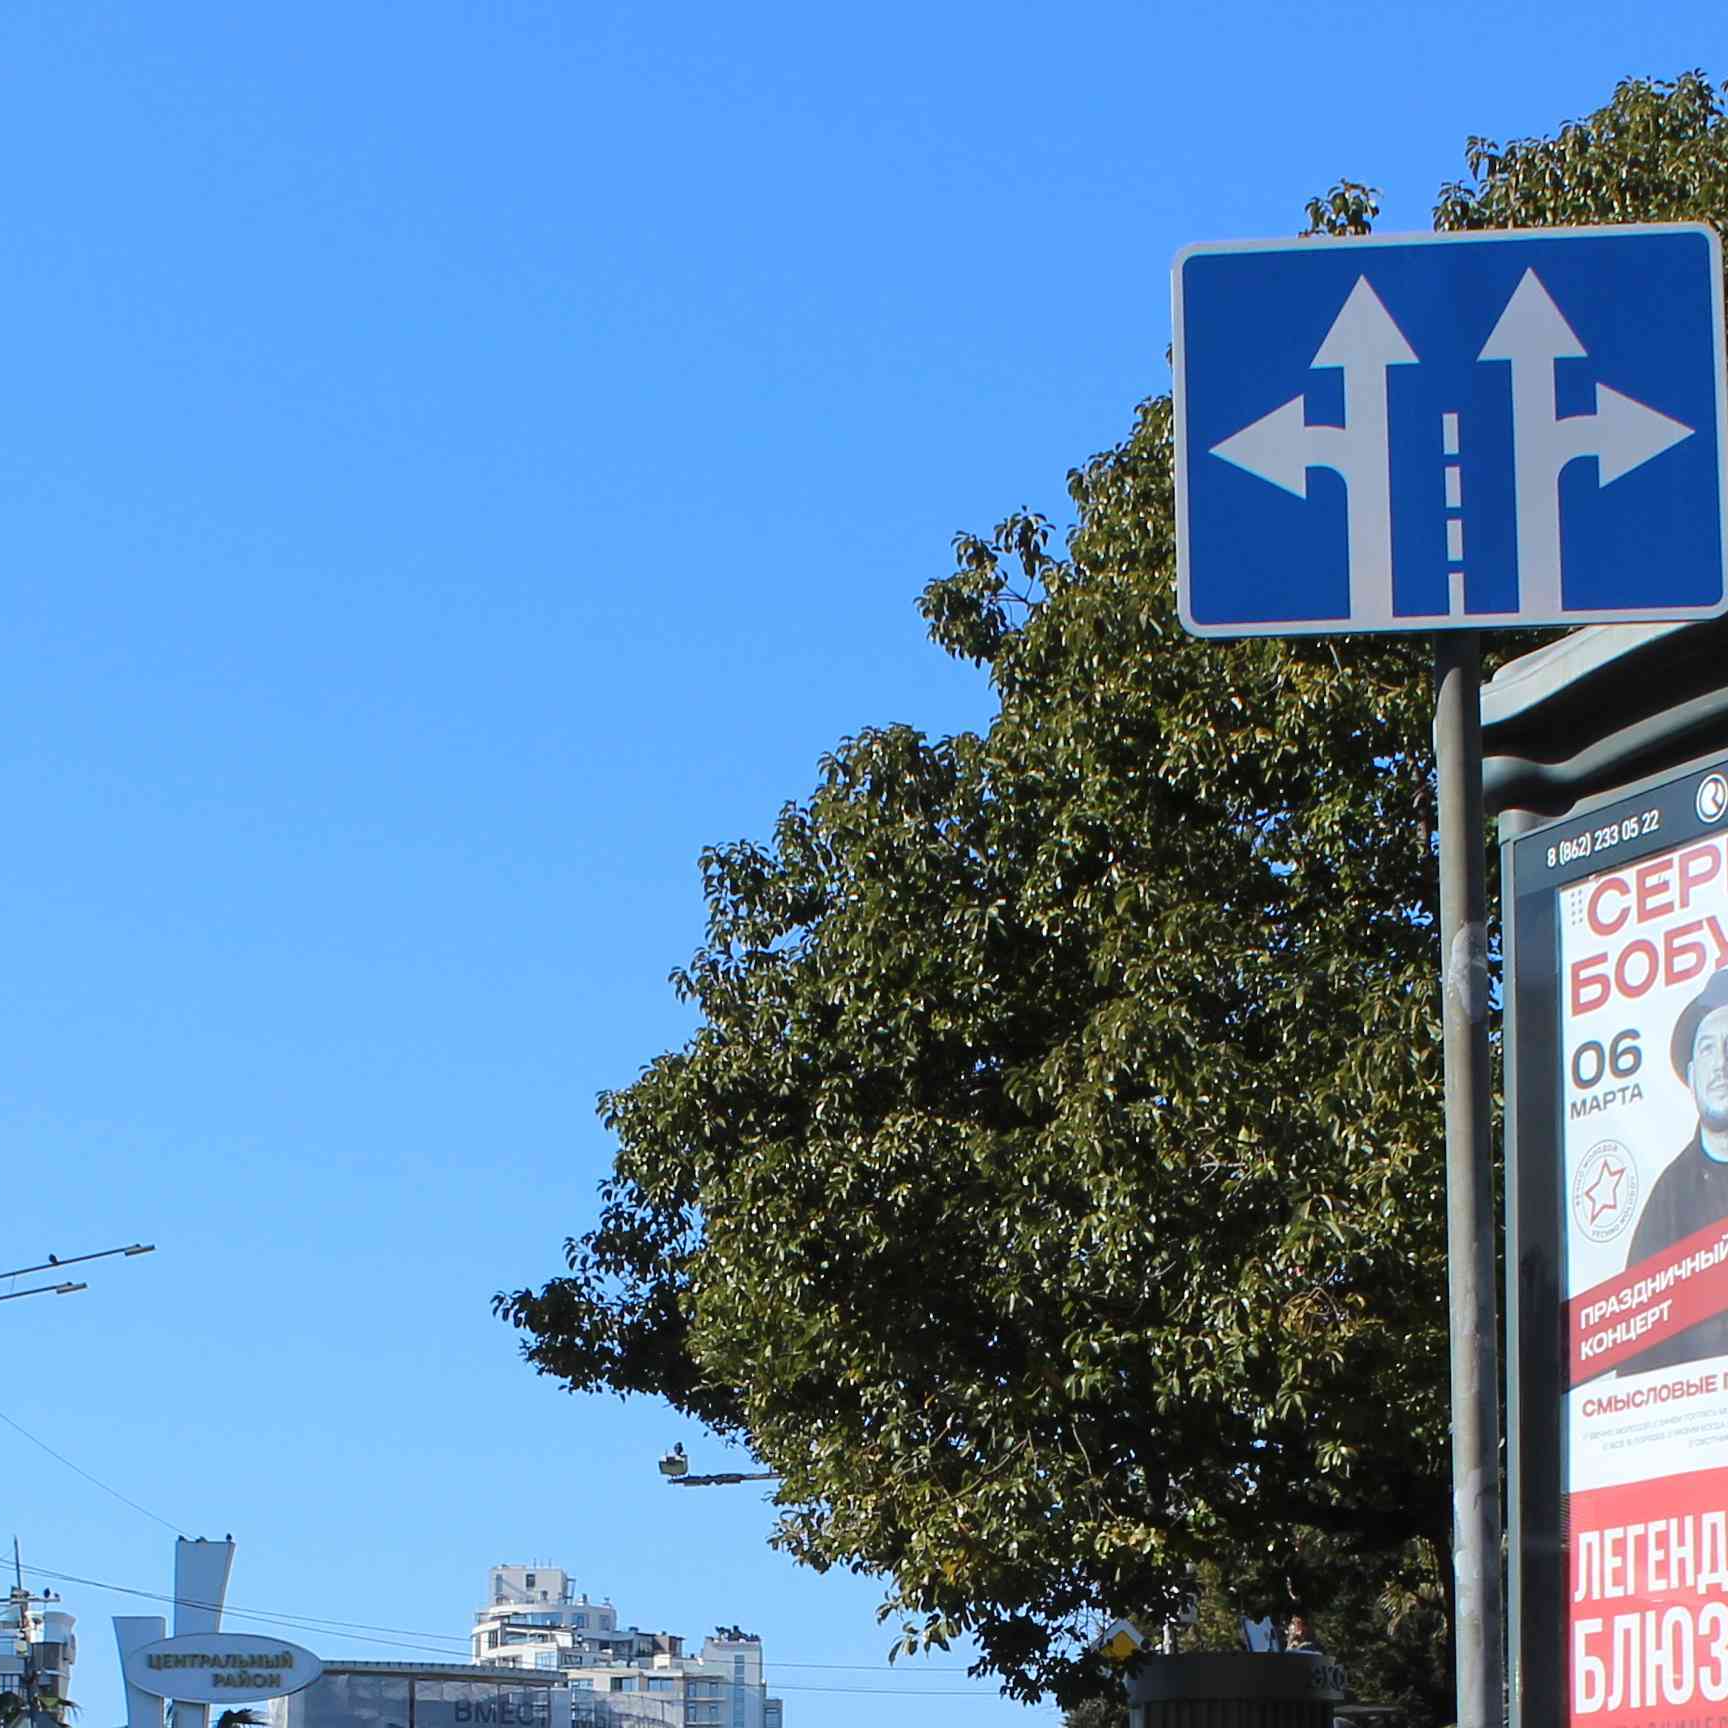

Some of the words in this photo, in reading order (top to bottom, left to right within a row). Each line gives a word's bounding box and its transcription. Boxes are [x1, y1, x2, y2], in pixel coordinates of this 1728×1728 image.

[1547, 848, 1556, 867] 8
[1559, 832, 1591, 865] (862)
[1594, 825, 1619, 851] 233
[1622, 816, 1639, 840] 05
[1642, 809, 1659, 834] 22
[1571, 1028, 1643, 1090] 06
[1571, 1084, 1643, 1120] МАРТА
[1579, 1299, 1673, 1361] КОНЦЕРТ
[1582, 1374, 1718, 1418] СМЫСЛОВЫЕ
[147, 1651, 293, 1670] ЦЕНТРАЛЬНЫЙ
[213, 1671, 281, 1688] РАЙОН
[455, 1700, 551, 1728] ВМЕСТ
